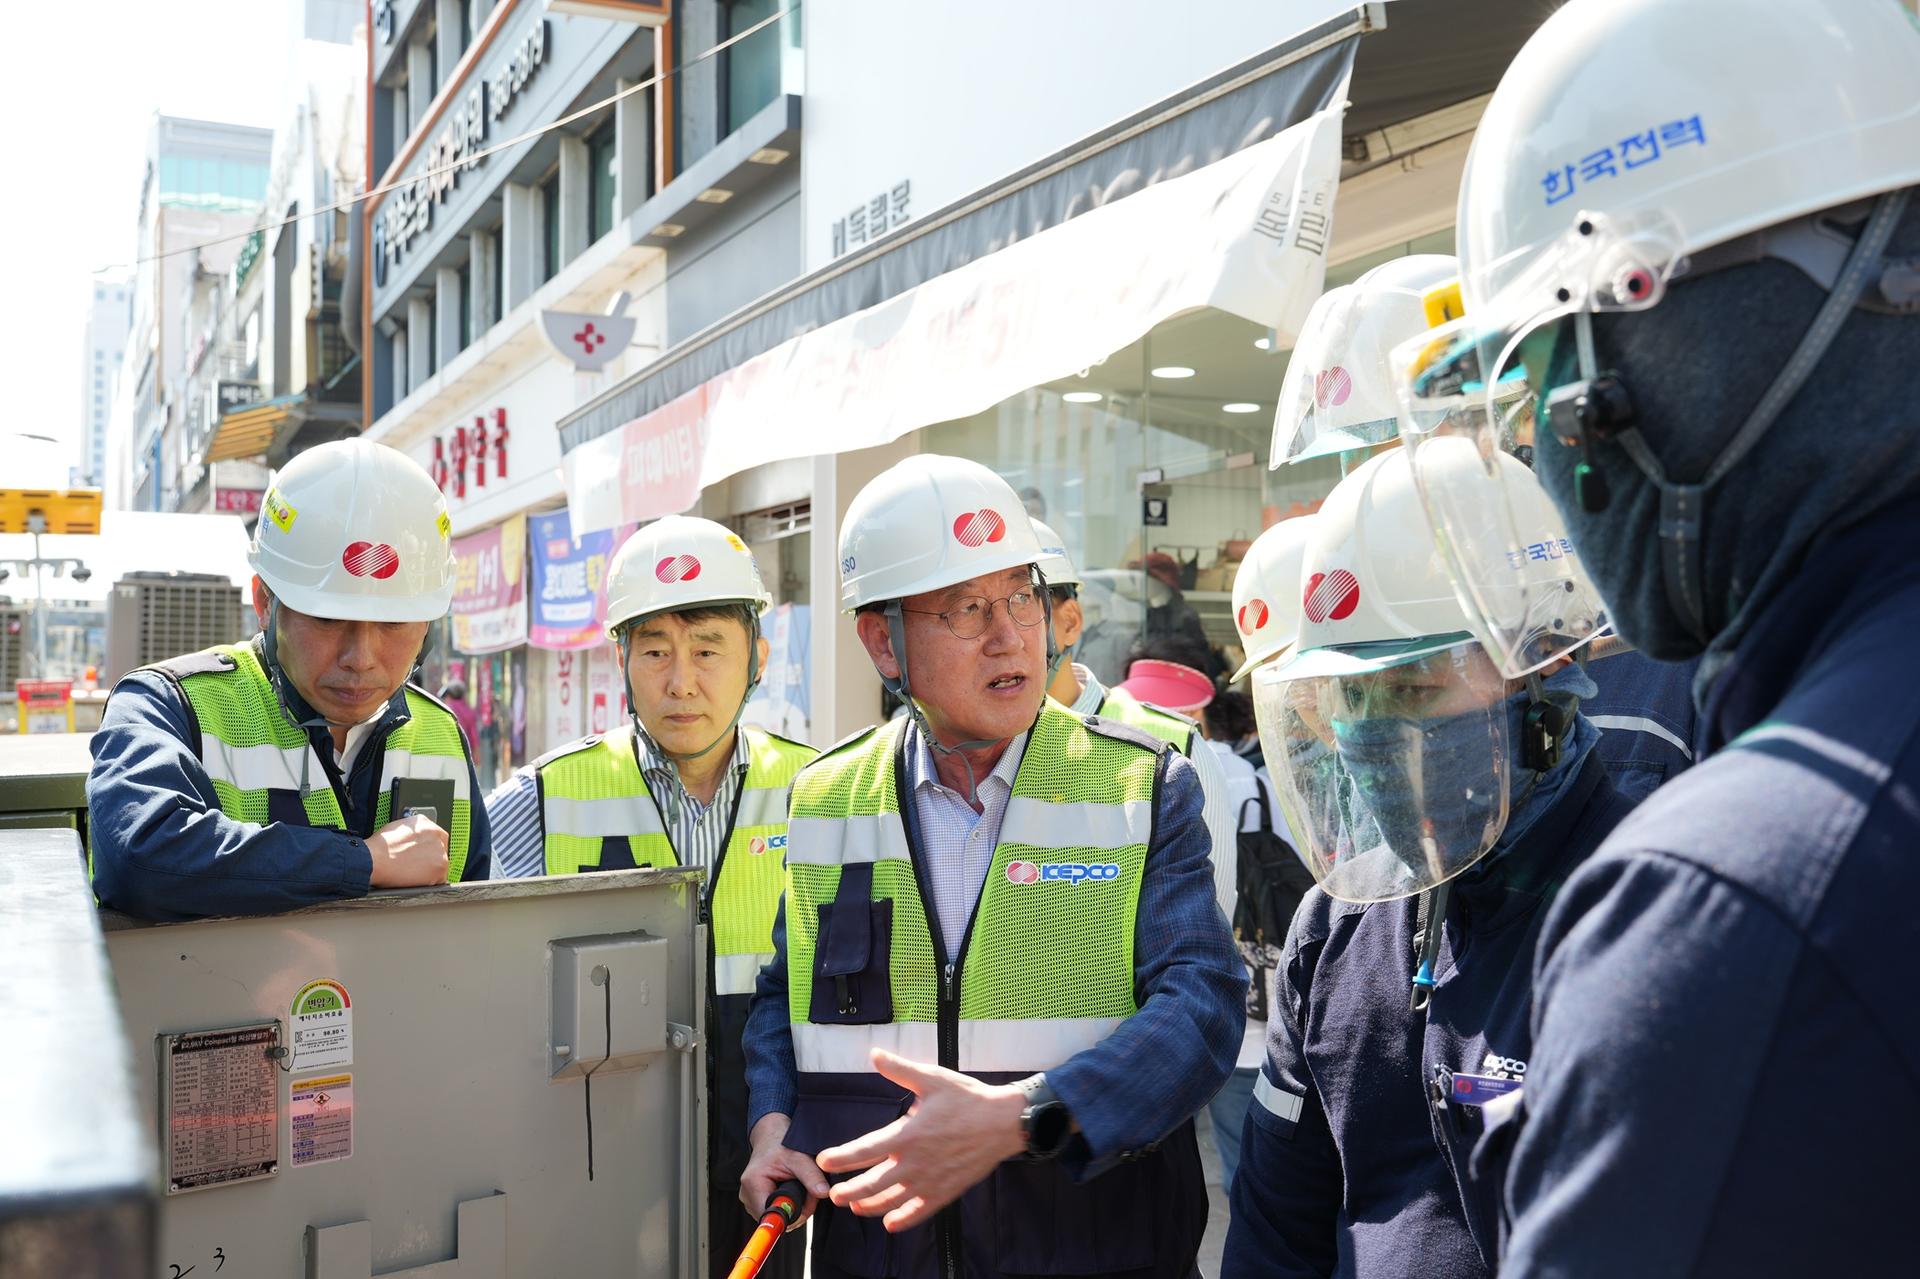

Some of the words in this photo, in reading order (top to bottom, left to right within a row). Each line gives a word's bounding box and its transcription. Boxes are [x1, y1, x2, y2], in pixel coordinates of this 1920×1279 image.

[1541, 113, 1706, 206] 한국전력
[1042, 864, 1120, 885] KEPCO
[307, 996, 335, 1010] 변압기
